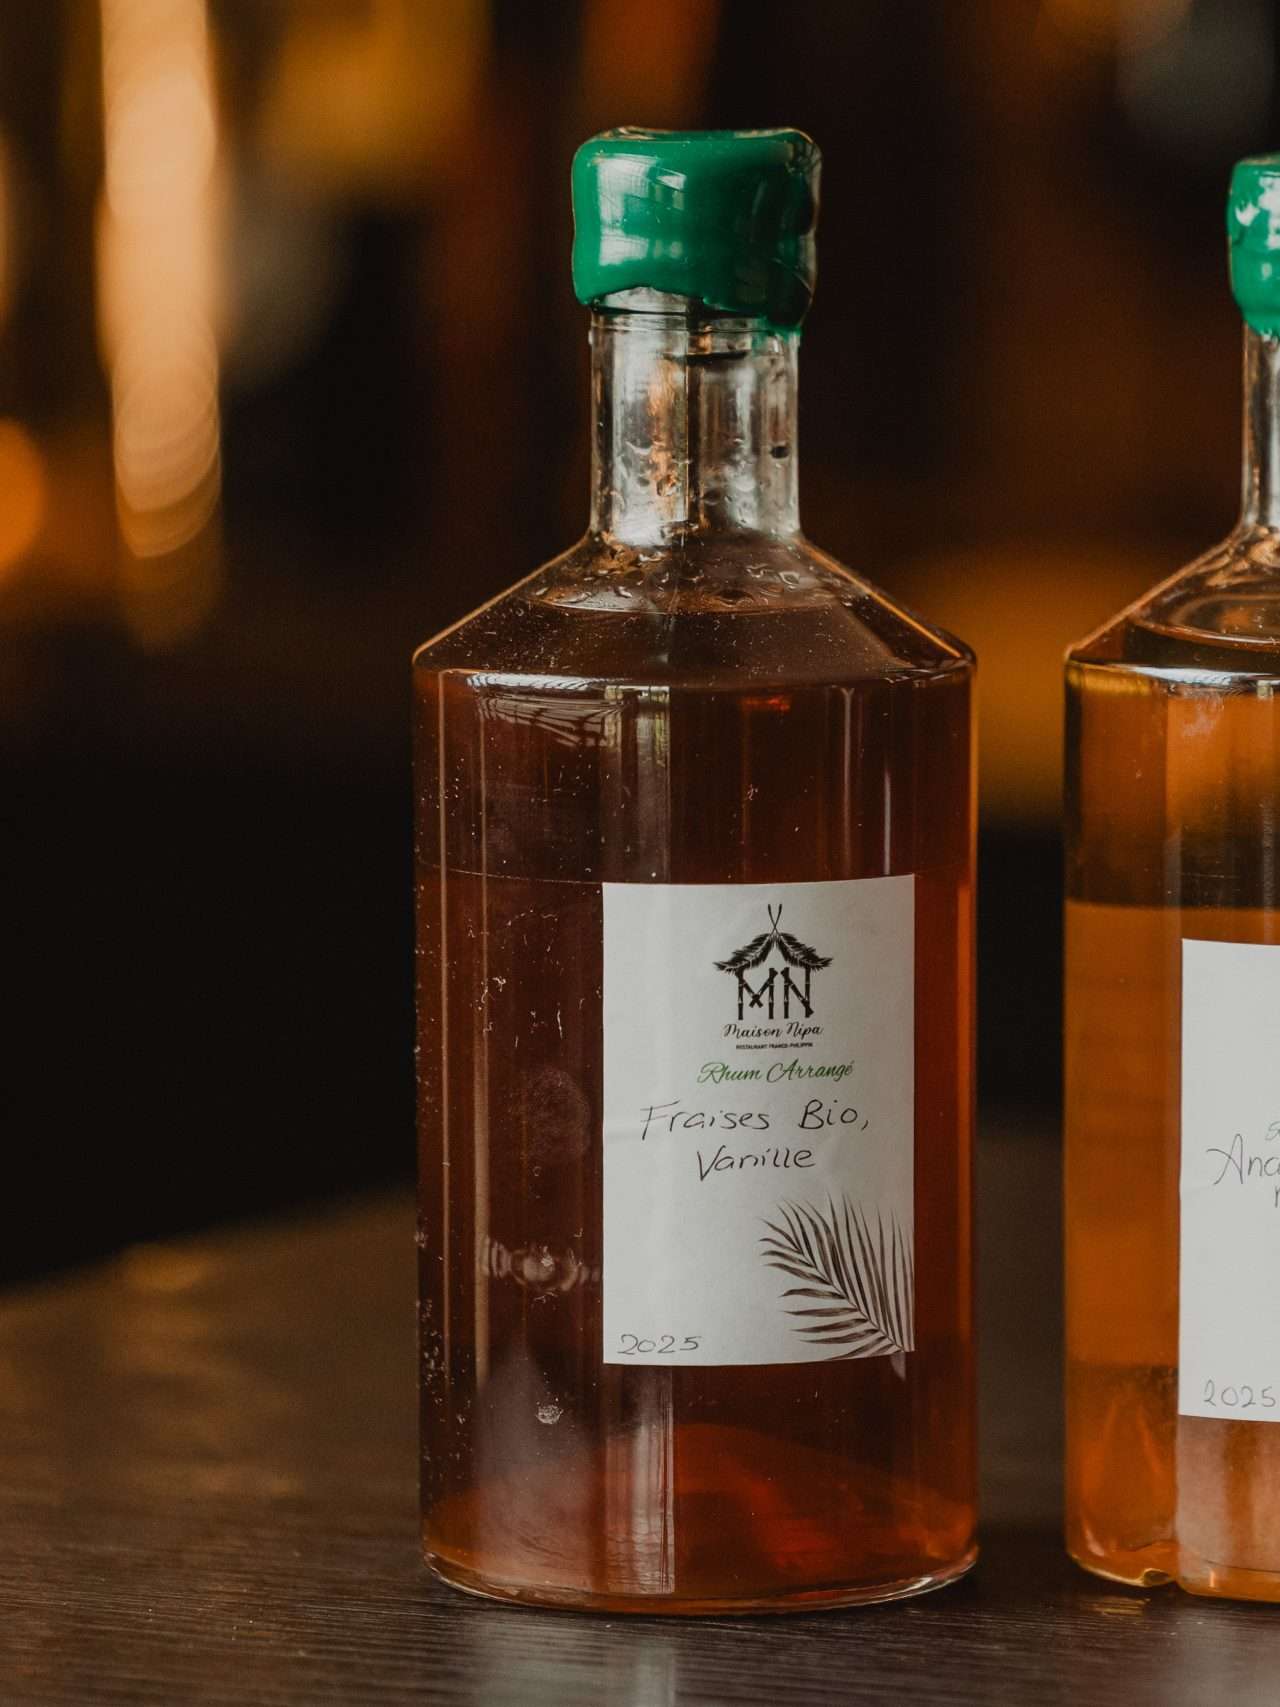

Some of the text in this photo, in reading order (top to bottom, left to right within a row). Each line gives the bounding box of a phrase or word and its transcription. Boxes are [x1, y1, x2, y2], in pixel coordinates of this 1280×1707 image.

[723, 1021, 824, 1040] Maison Nipa
[697, 1057, 856, 1084] Rhum Arrangé
[639, 1098, 870, 1141] Fraises Bio,
[696, 1144, 817, 1182] Vanille
[617, 1333, 703, 1356] 2025
[1203, 1378, 1278, 1409] 2025
